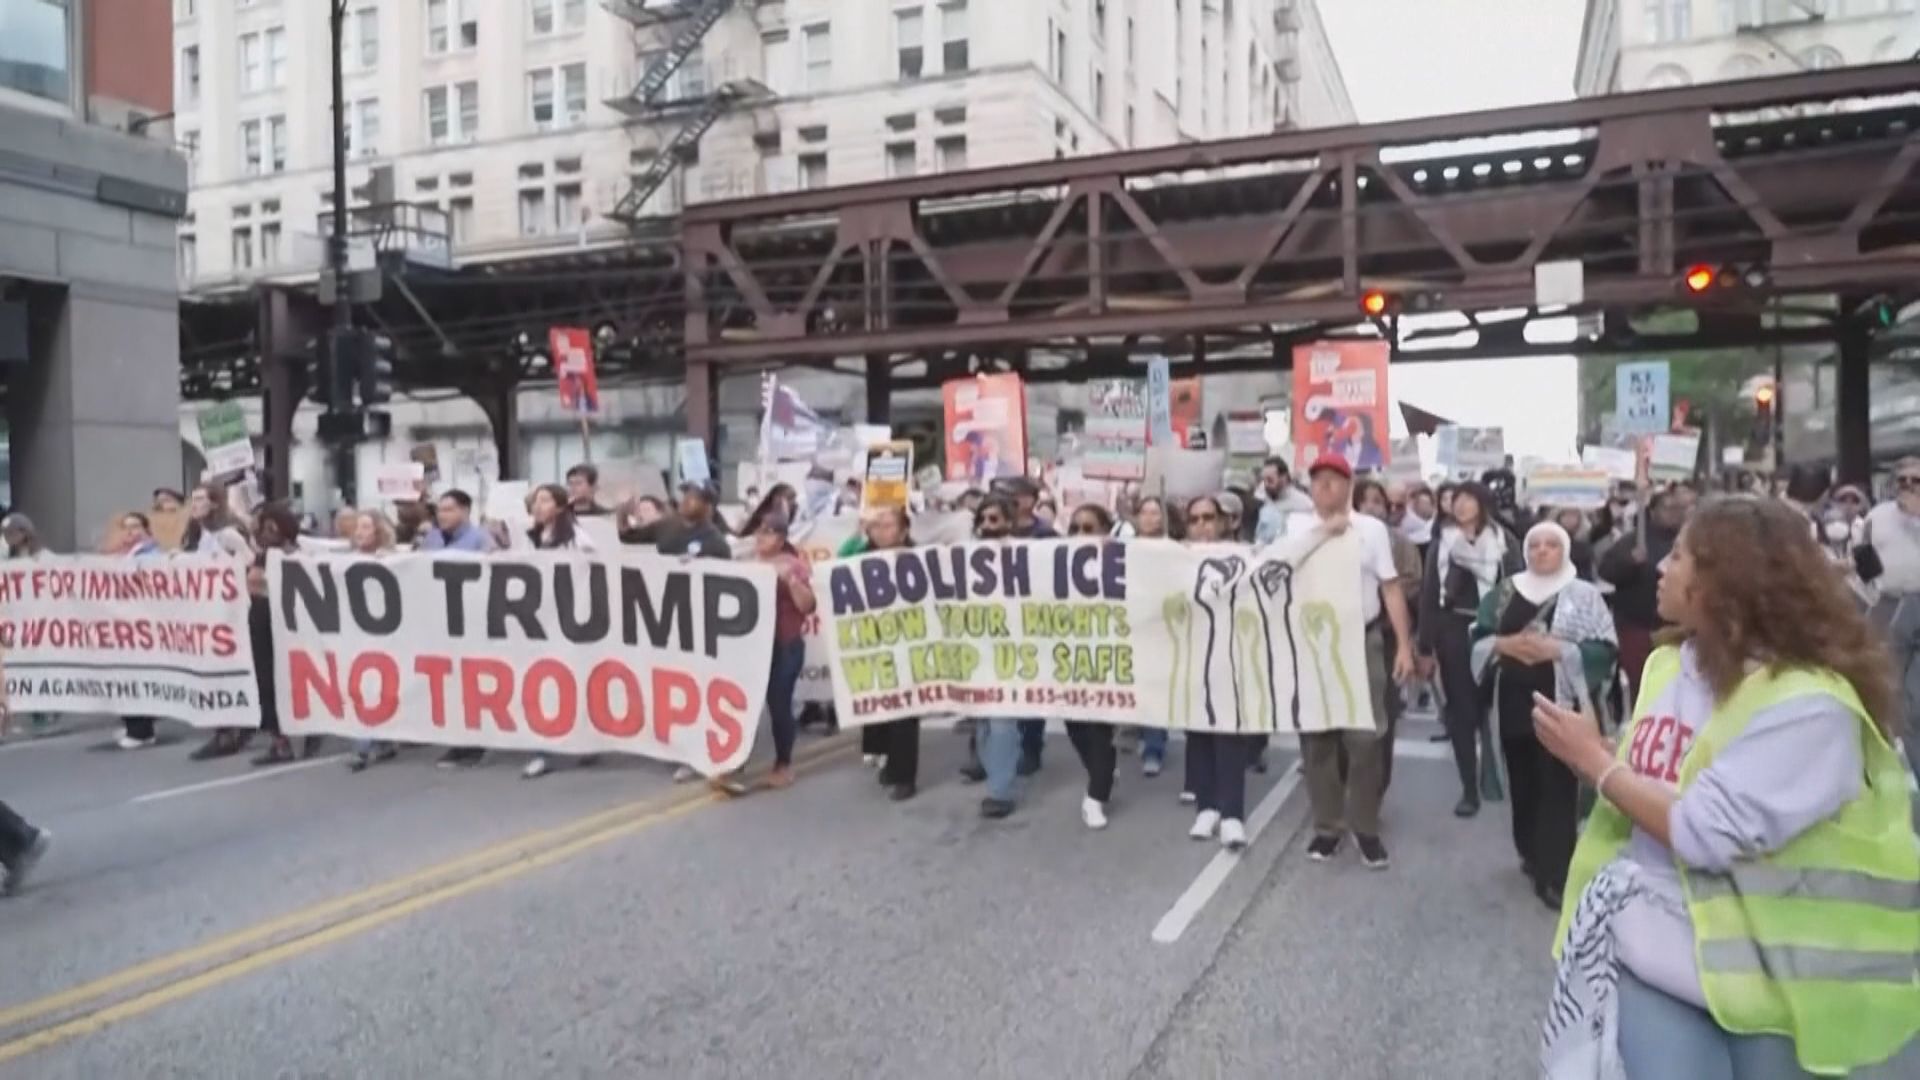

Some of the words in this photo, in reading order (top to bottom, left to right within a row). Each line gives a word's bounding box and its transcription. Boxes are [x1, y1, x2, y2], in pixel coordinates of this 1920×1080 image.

[32, 570, 76, 599] FOR
[830, 545, 1031, 615] ABOLISH
[1053, 543, 1126, 600] ICE
[281, 560, 402, 635] NO
[433, 560, 760, 658] TRUMP
[836, 606, 927, 649] KNOW
[935, 603, 1009, 637] YOUR
[1021, 603, 1131, 638] RIGHTS
[22, 617, 153, 650] WORKERS
[157, 621, 238, 657] RIGHTS
[840, 651, 900, 693] WE
[993, 641, 1039, 681] US
[1053, 641, 1135, 685] SAFE
[288, 649, 400, 727] NO
[414, 654, 748, 763] TROOPS
[852, 690, 913, 716] REPORT
